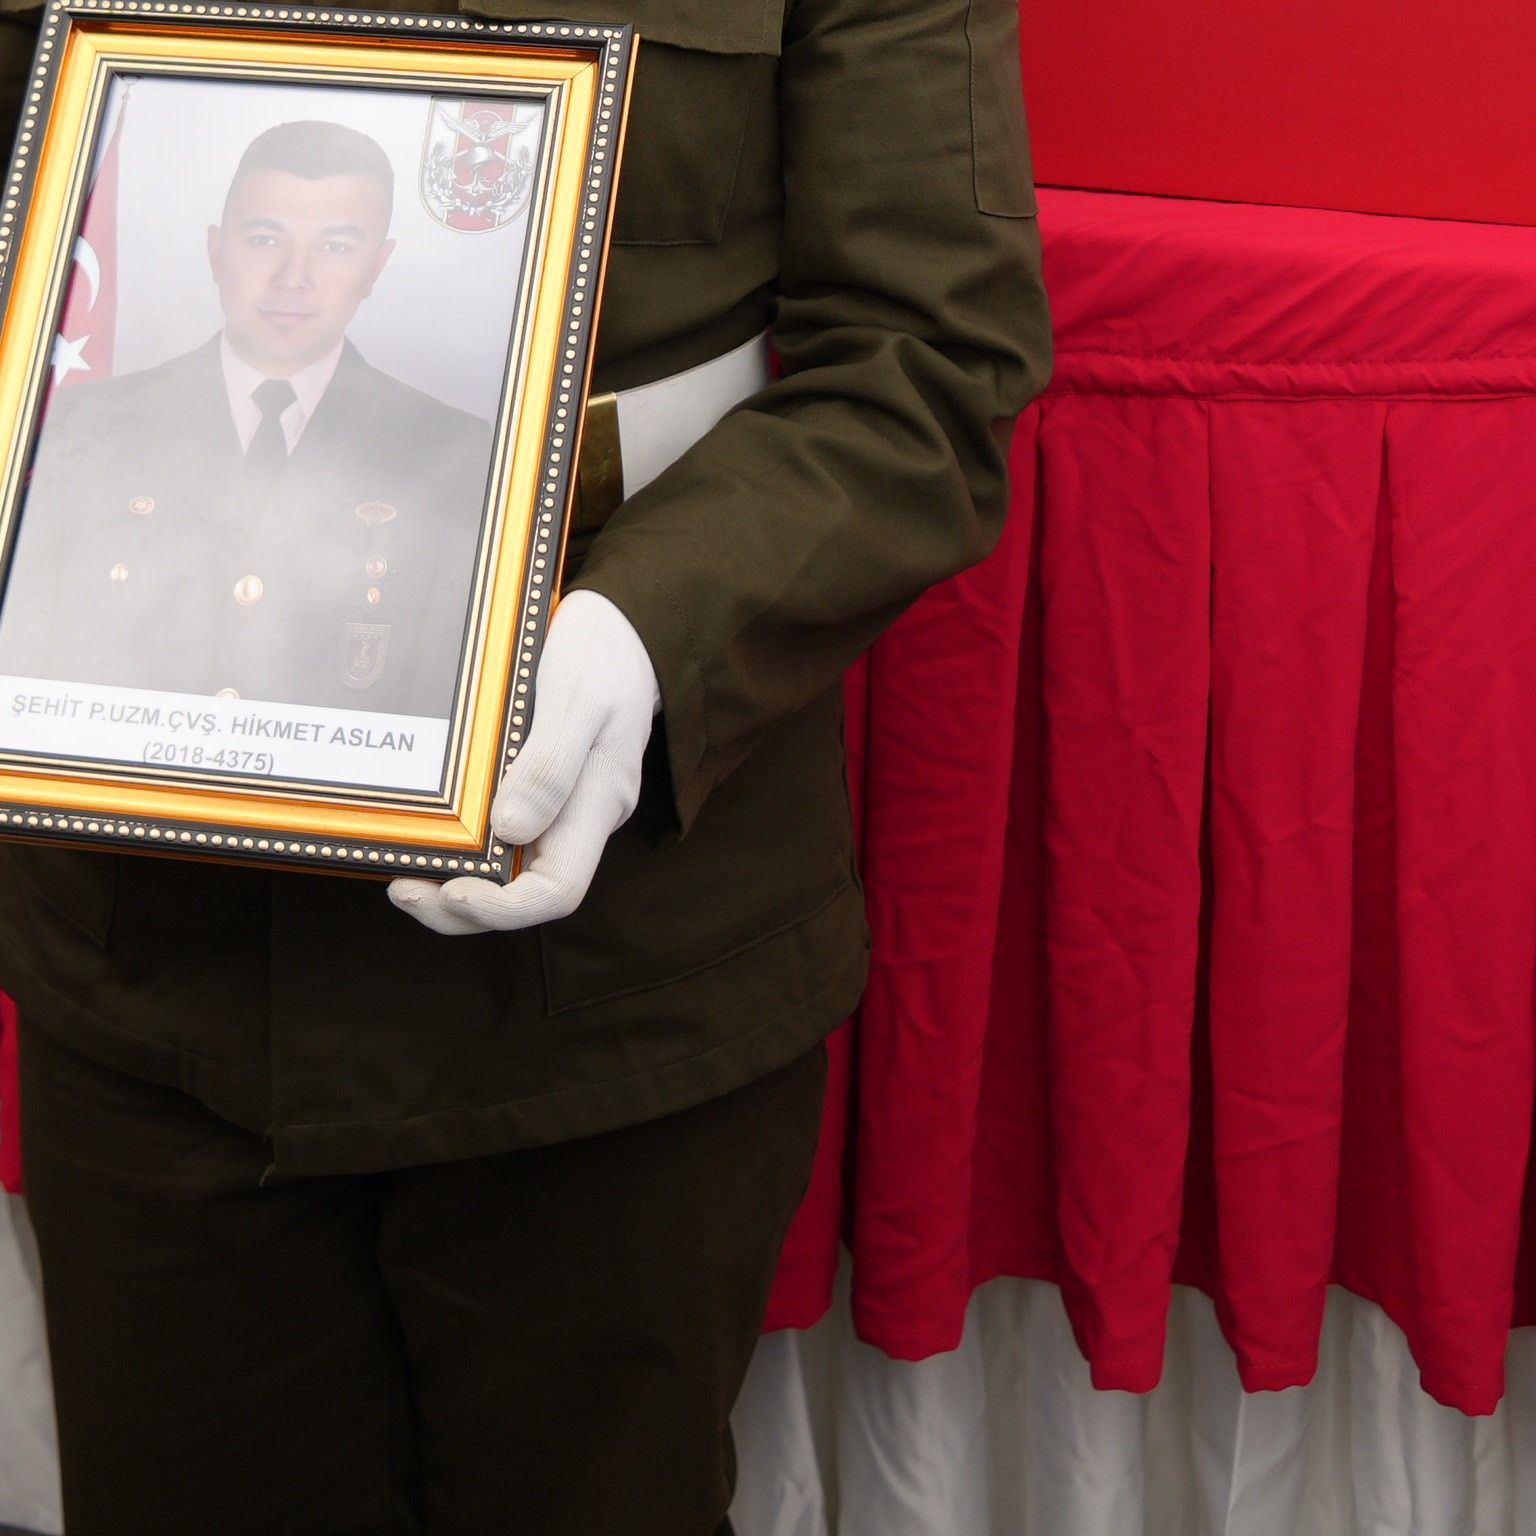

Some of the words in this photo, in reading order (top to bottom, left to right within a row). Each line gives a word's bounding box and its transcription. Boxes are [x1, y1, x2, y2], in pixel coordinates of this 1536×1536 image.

[11, 694, 82, 719] ŞEHİT
[232, 712, 325, 742] HİKMET
[330, 726, 416, 752] ASLAN
[143, 740, 275, 774] (2018-4375)
